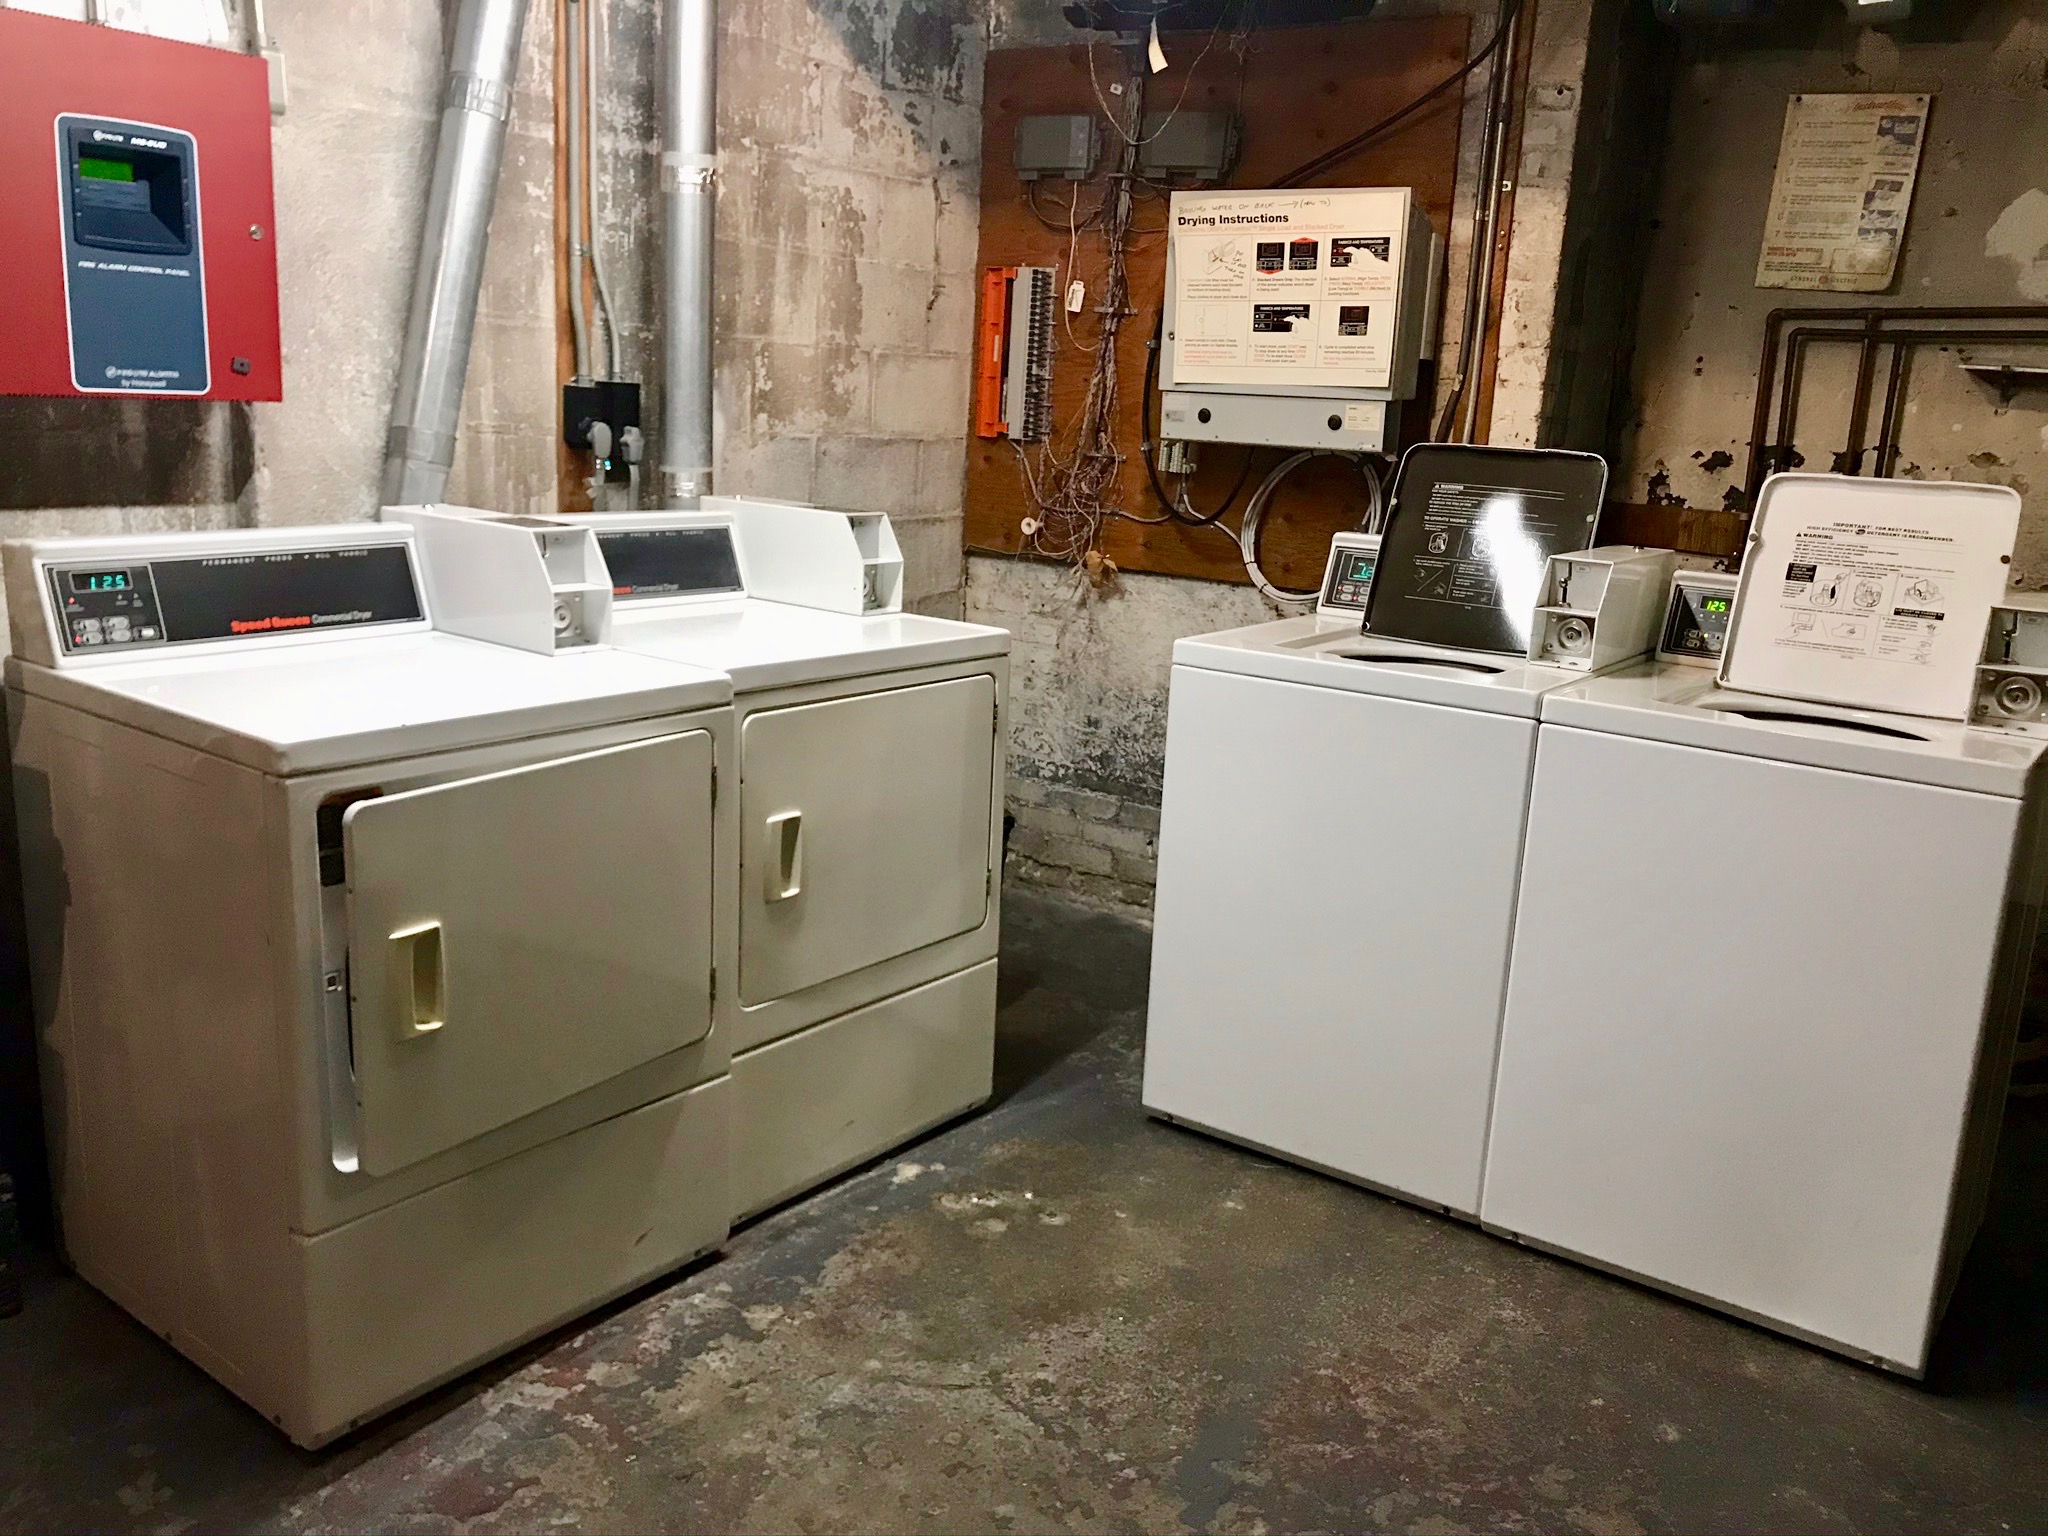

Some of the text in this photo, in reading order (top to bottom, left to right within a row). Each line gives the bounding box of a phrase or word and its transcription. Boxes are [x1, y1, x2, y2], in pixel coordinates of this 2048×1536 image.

[1178, 213, 1289, 227] Drying Instructions
[1329, 223, 1345, 231] Dryer
[97, 262, 127, 271] ALARM
[127, 264, 164, 275] CONTROL
[164, 268, 191, 277] PANEL
[1803, 532, 1834, 541] WARNING
[1821, 526, 1854, 534] EFFICIENCY
[1866, 530, 1901, 538] DETERGENT
[264, 554, 293, 563] PRESS
[338, 549, 369, 557] FABRIC
[90, 573, 125, 591] 125
[1706, 600, 1726, 613] 125
[230, 609, 373, 633] Speed Queen Commercial Dryer
